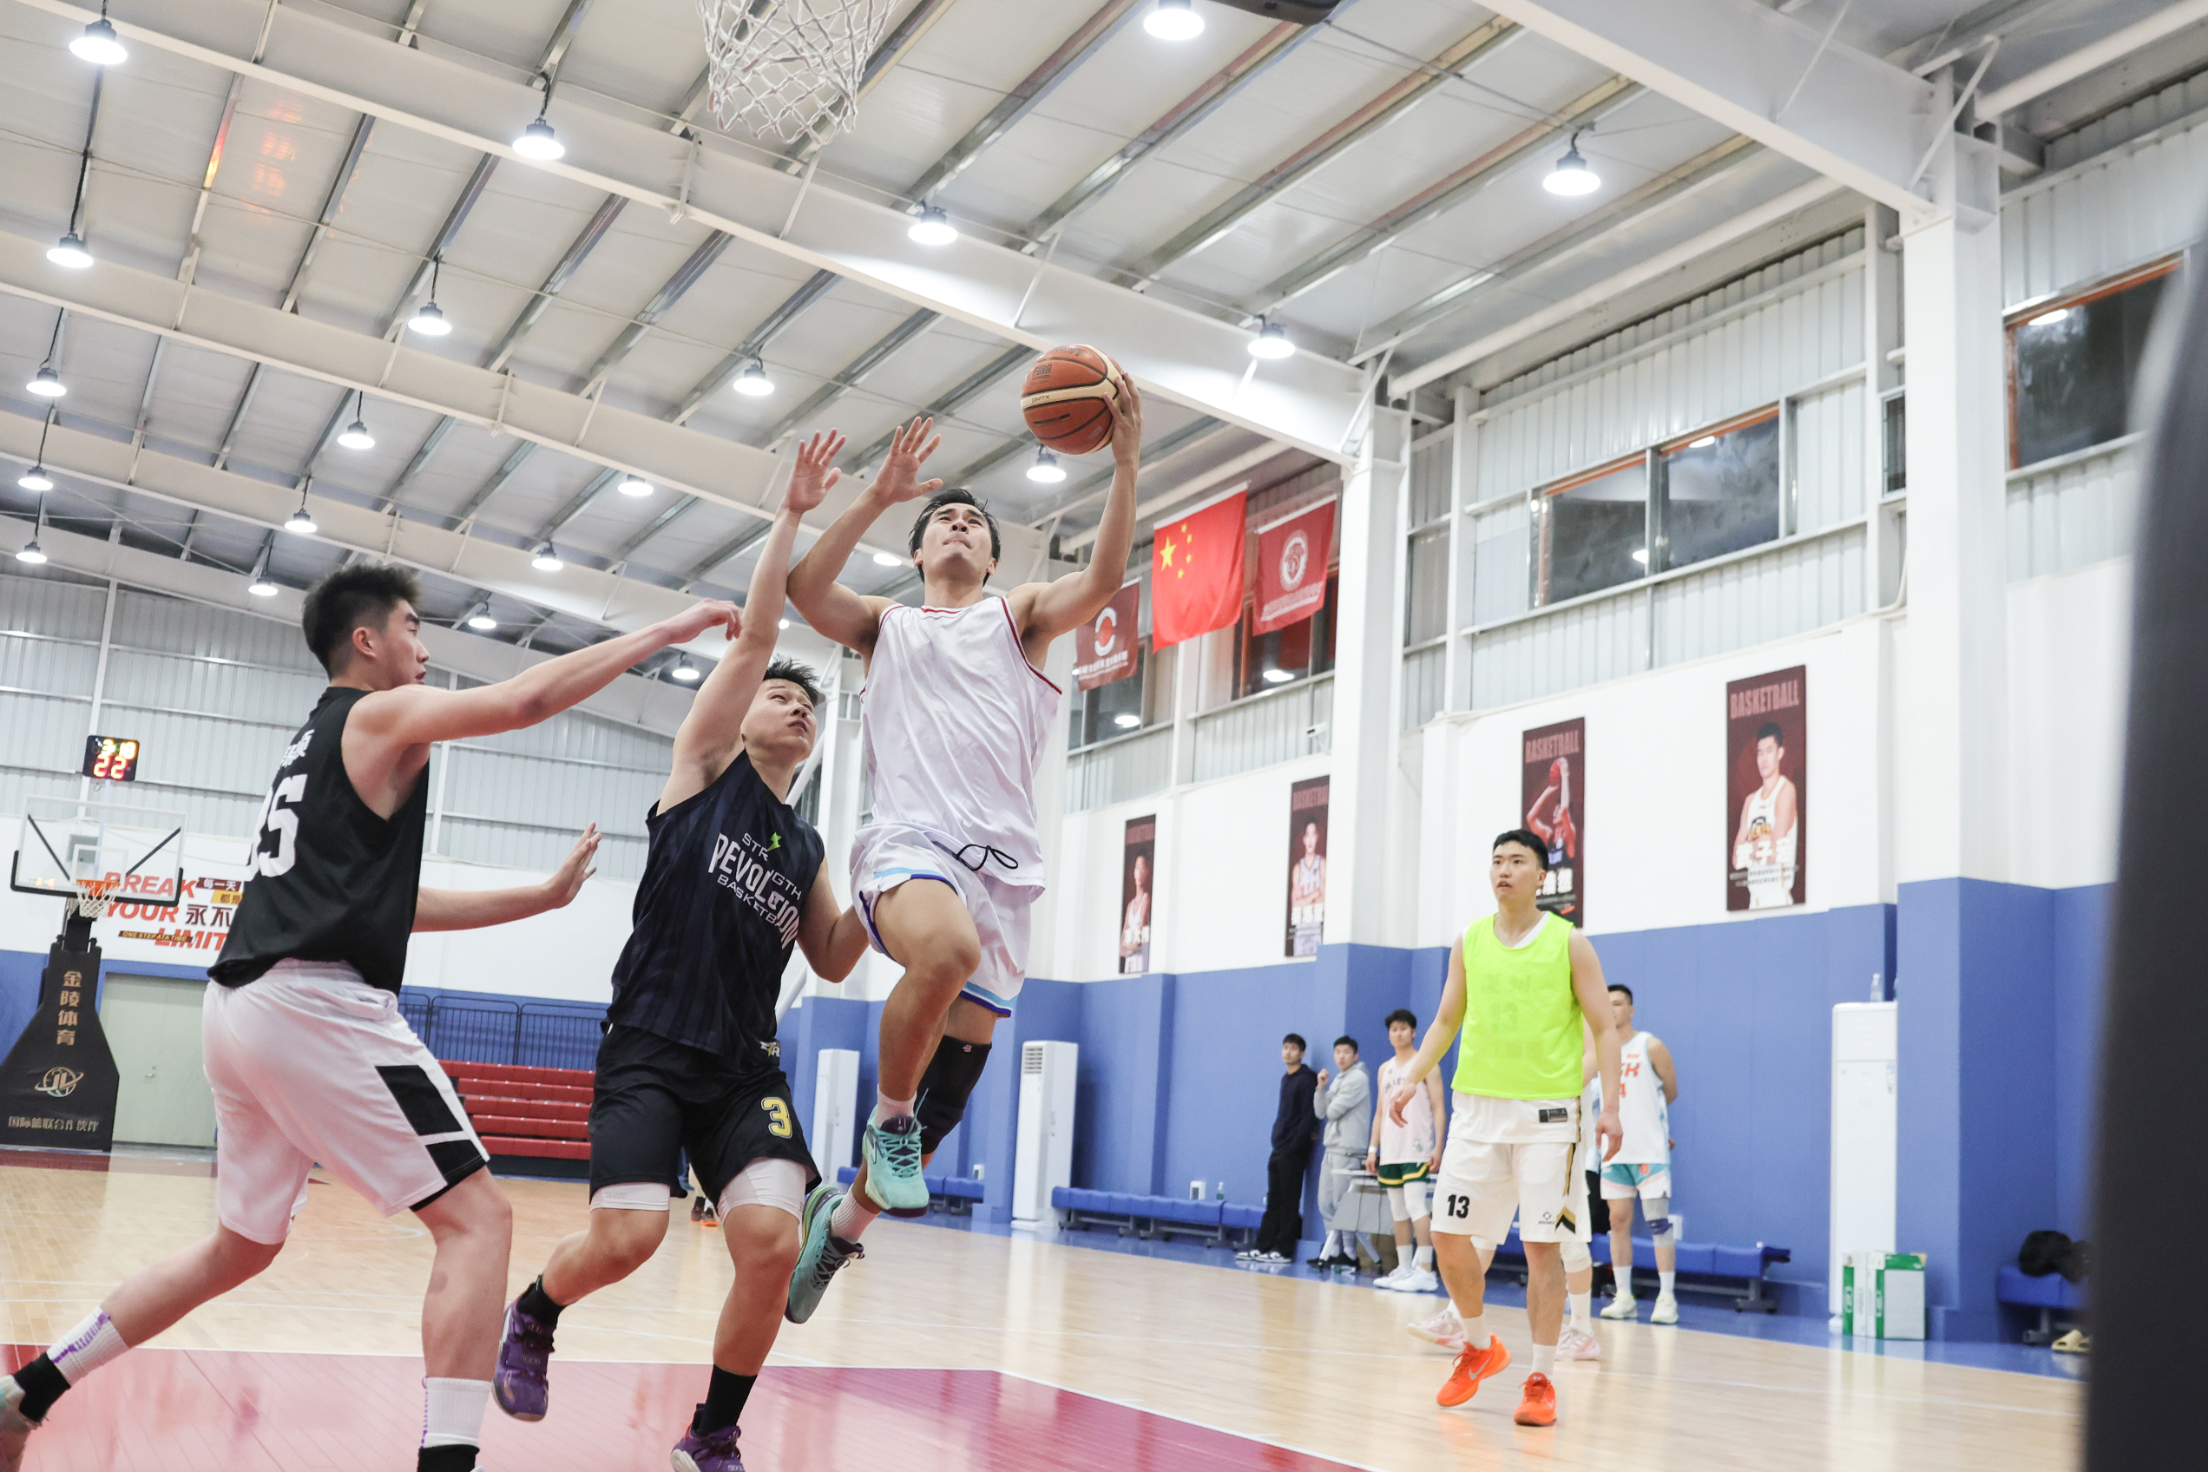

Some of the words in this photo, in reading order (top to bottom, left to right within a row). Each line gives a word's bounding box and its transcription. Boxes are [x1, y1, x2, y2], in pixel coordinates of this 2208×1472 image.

[1730, 679, 1800, 719] BASKETBALL
[93, 754, 127, 779] 22
[56, 970, 83, 1046] 金陵体育
[760, 1096, 793, 1139] 3
[1446, 1194, 1471, 1219] 13
